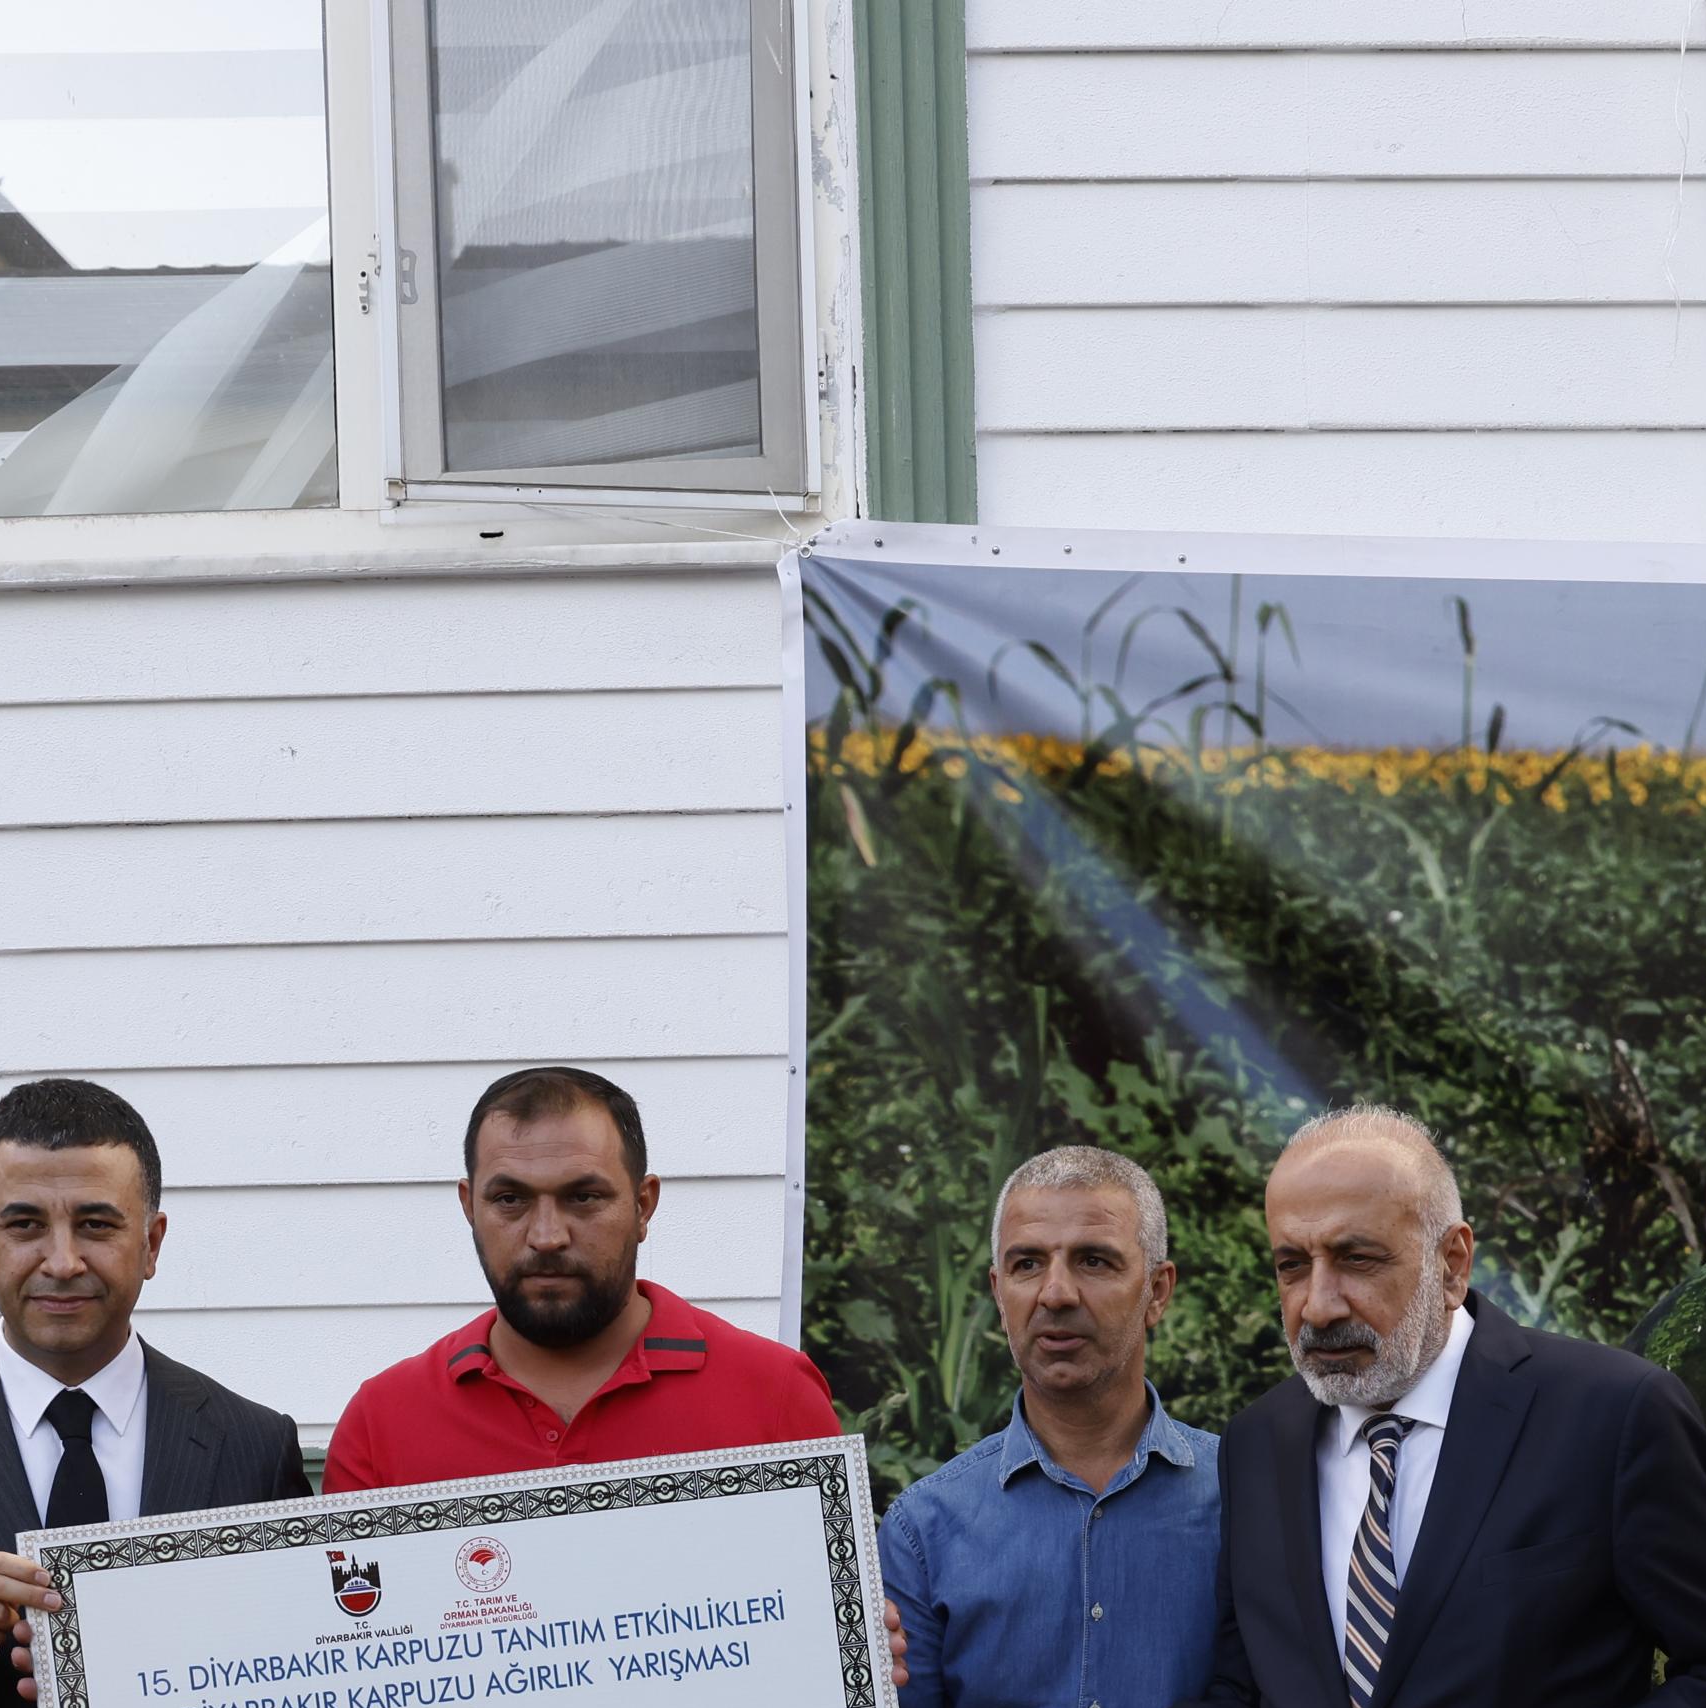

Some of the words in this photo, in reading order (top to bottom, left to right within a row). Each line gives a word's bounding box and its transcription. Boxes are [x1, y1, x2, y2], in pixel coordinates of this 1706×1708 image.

[455, 1599, 472, 1609] T.C.
[474, 1596, 503, 1607] TARIM
[505, 1594, 518, 1602] VE
[443, 1609, 479, 1621] ORMAN
[481, 1602, 533, 1617] BAKANLIĞI
[354, 1621, 372, 1631] T.C.
[439, 1618, 483, 1630] DİYARBAKIR
[137, 1669, 179, 1697] 15.
[188, 1648, 348, 1691] DİYARBAKIR
[355, 1632, 483, 1671] KARPUZU
[491, 1617, 606, 1655] TANITIM
[613, 1588, 786, 1641] ETKİNLİKLERİ
[315, 1631, 373, 1645] DİYARBAKIR
[374, 1624, 414, 1638] VALİLİĞİ
[485, 1659, 594, 1698] AĞIRLIK
[608, 1640, 751, 1682] YARIŞMASI
